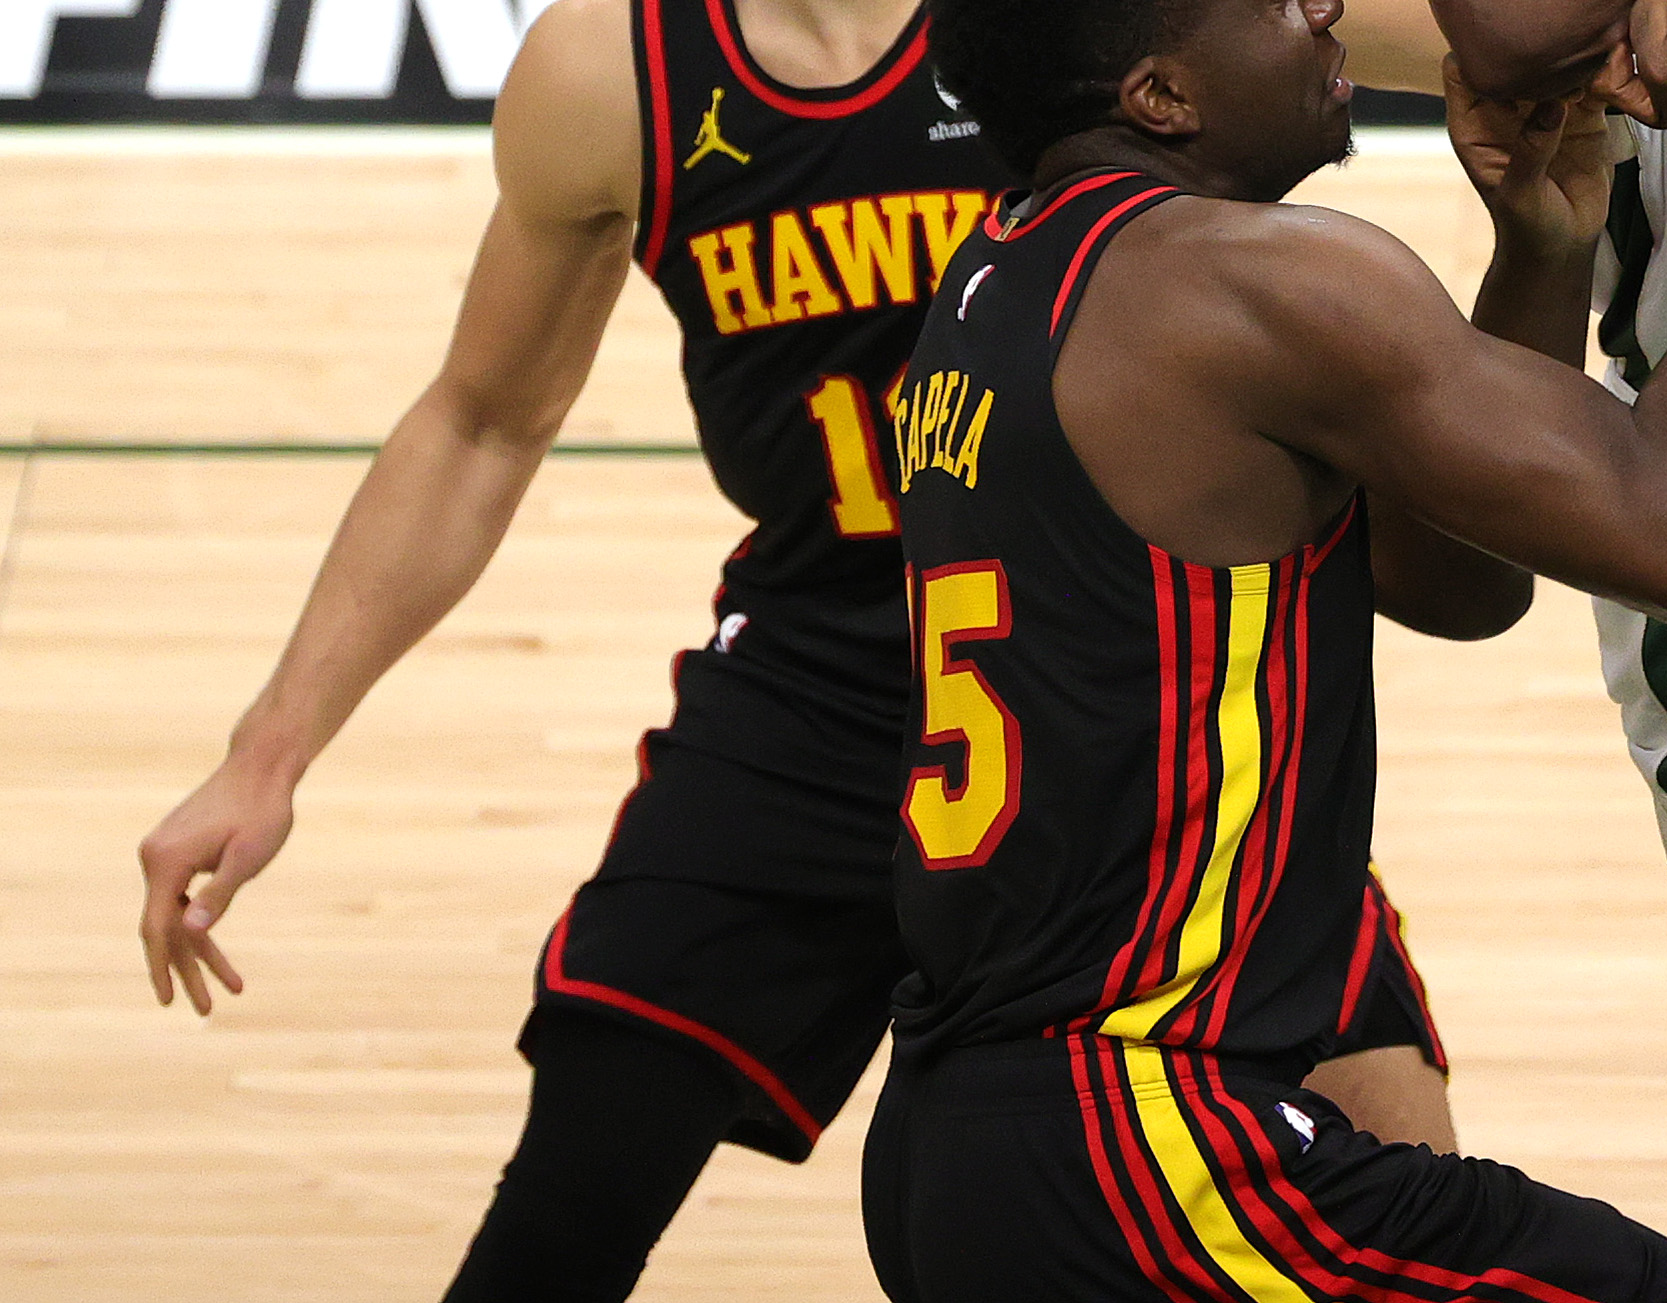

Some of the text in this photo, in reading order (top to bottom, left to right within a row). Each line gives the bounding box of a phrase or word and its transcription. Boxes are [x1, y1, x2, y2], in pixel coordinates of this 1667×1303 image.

[928, 121, 981, 141] share
[688, 188, 1002, 336] HAWK
[803, 362, 911, 539] 1
[894, 370, 995, 494] CAPELA
[899, 558, 1022, 871] 5
